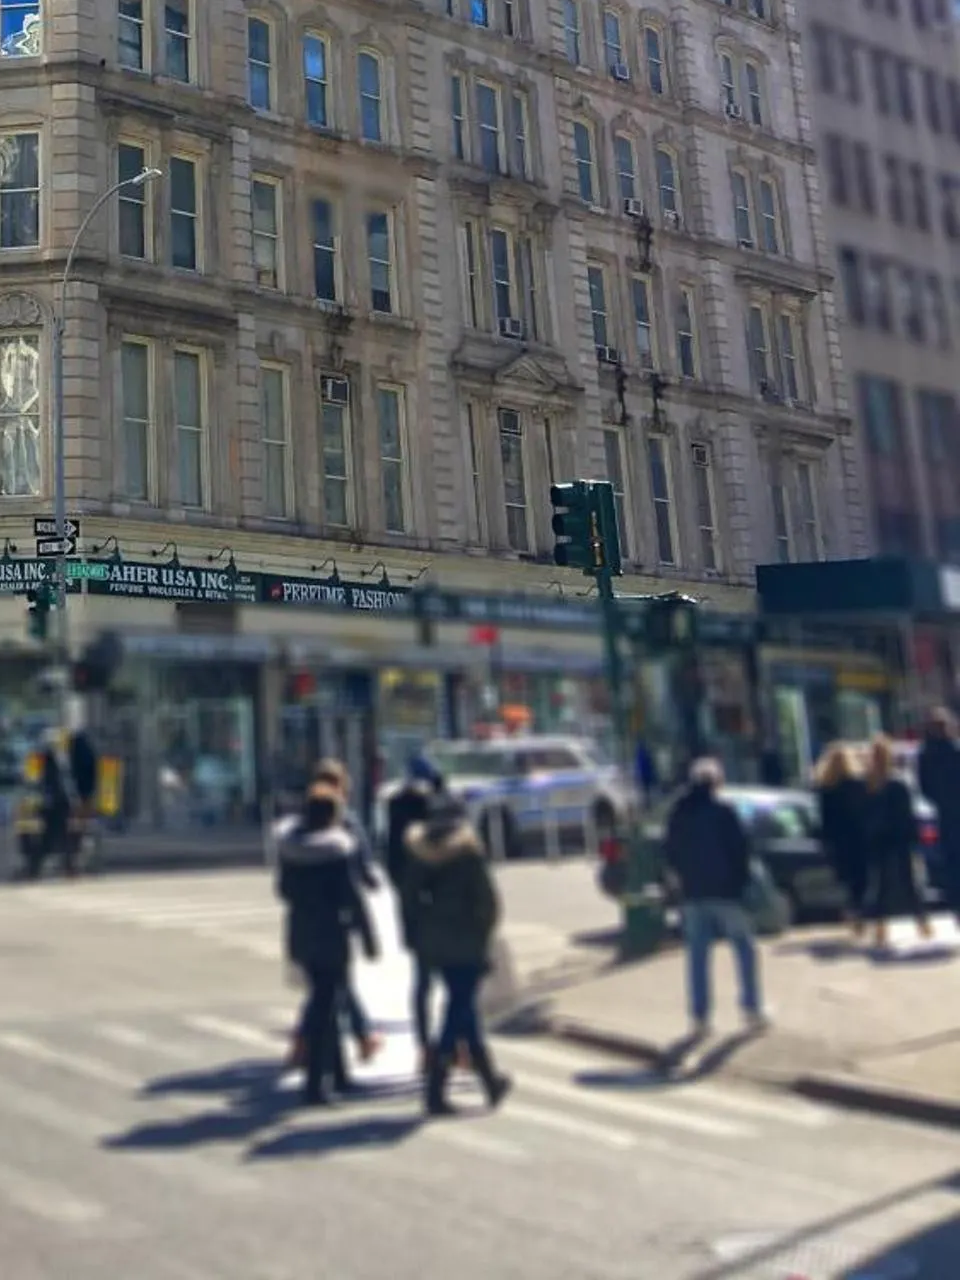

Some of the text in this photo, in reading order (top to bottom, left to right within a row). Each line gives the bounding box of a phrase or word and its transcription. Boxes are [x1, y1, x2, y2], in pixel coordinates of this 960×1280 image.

[24, 563, 50, 581] INC.
[162, 569, 198, 588] USA
[201, 572, 233, 591] INC.
[282, 583, 345, 604] PERFUME
